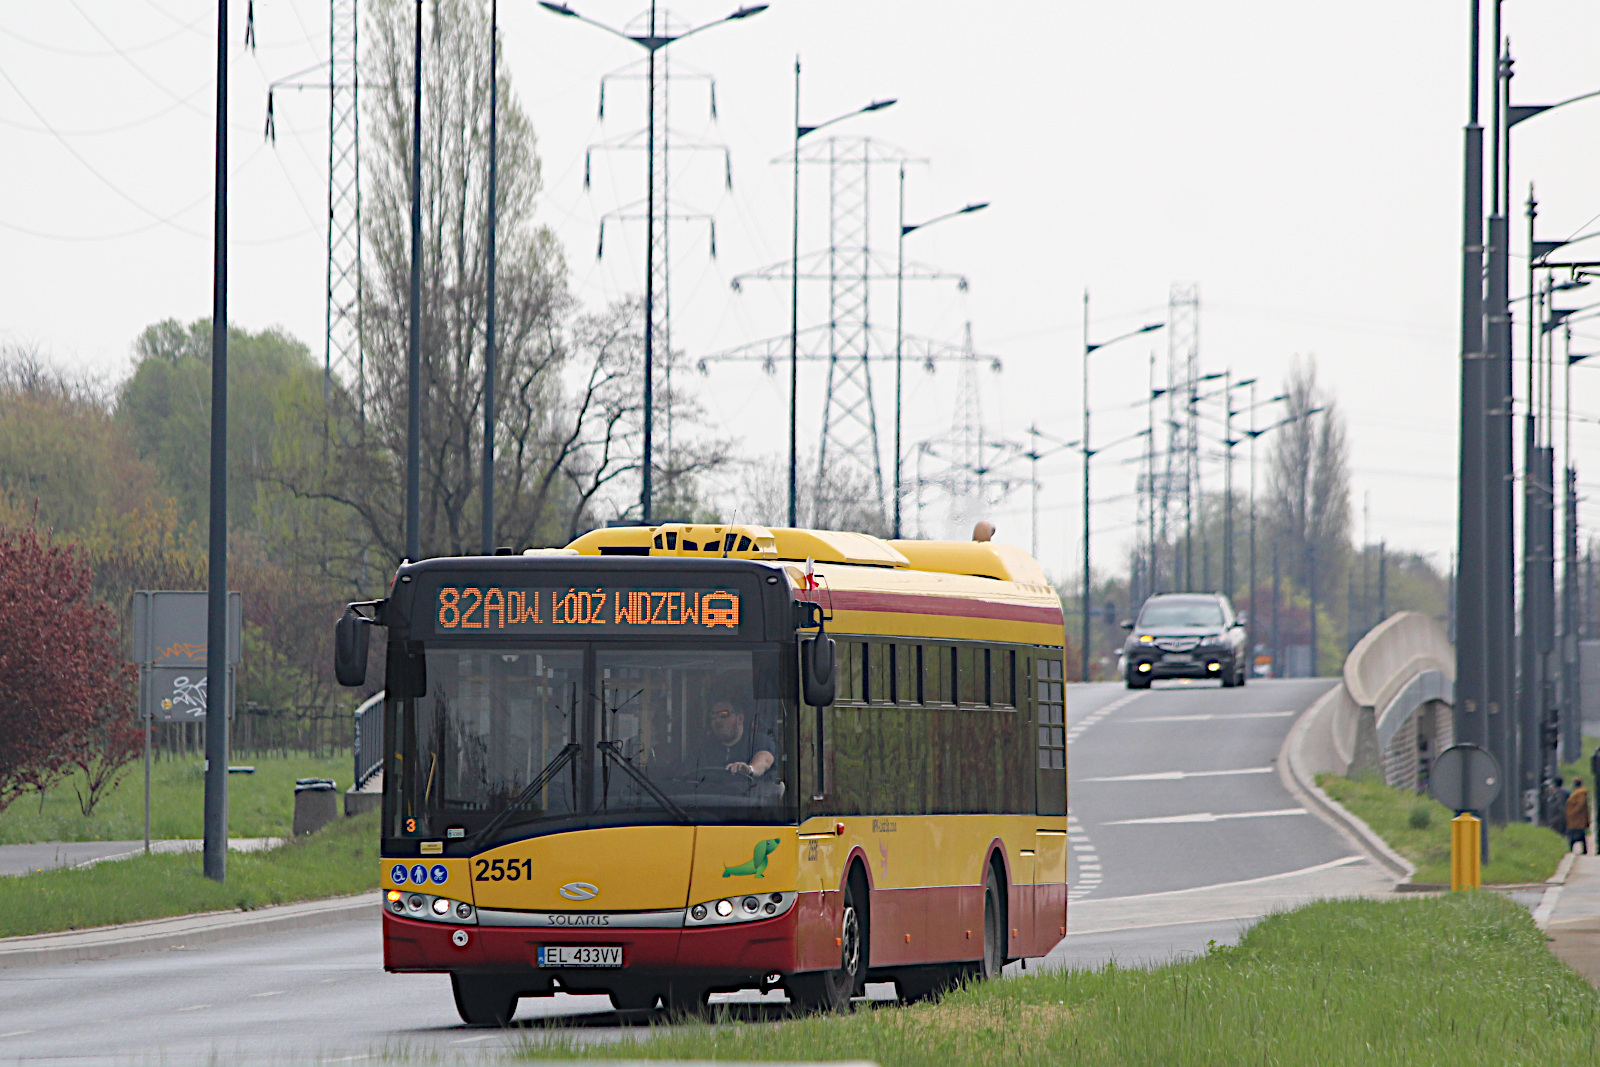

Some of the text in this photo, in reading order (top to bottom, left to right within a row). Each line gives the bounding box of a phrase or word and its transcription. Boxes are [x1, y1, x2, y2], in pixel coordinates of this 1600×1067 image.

[439, 588, 505, 628] 82A
[552, 588, 606, 624] ŁÓDŹ
[615, 591, 699, 624] WIDZEW
[406, 818, 417, 832] 3
[475, 858, 533, 881] 2551
[548, 915, 609, 925] SOLARIS
[547, 948, 568, 963] EL
[573, 948, 619, 963] 433VV
